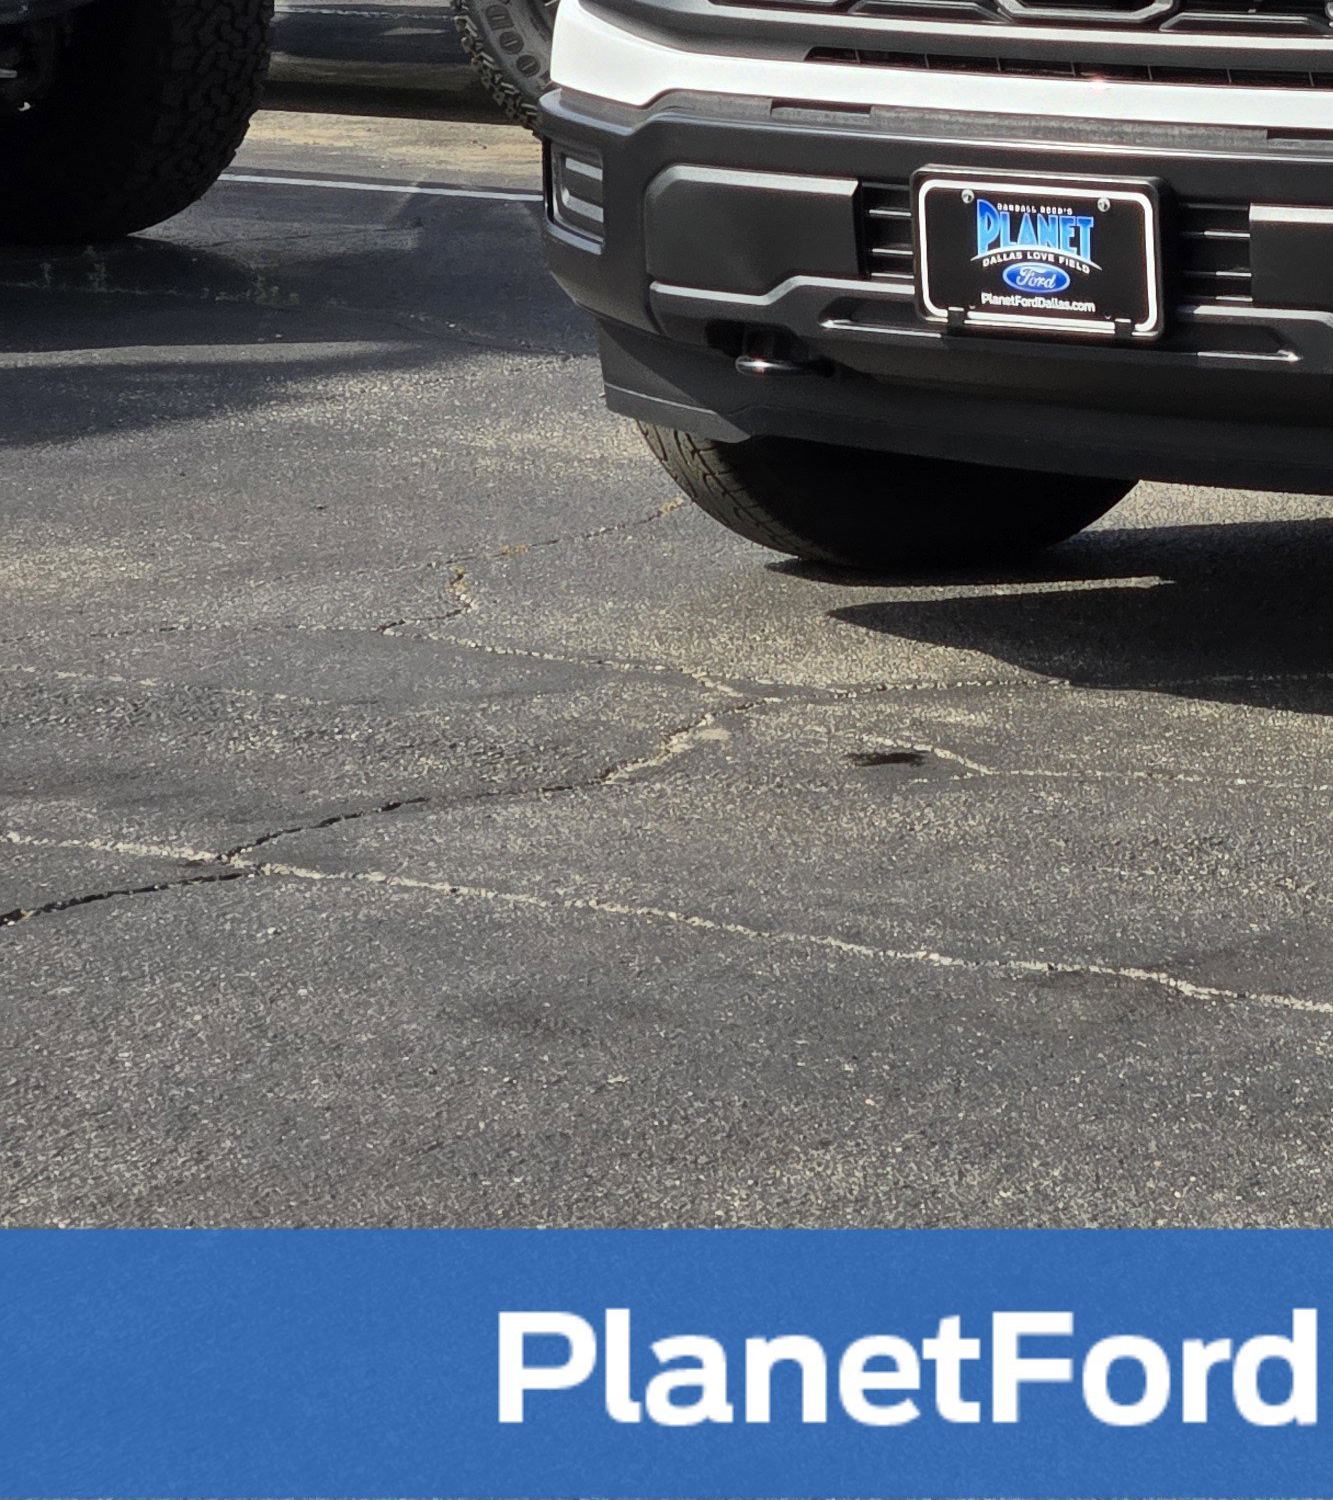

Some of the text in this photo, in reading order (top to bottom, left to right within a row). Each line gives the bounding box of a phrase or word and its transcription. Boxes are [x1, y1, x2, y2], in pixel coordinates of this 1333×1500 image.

[976, 199, 1095, 263] PLANET
[982, 251, 1091, 275] DALLAS LOVE FIELD
[1015, 266, 1057, 289] Ford
[980, 291, 1096, 313] PlanetFordDallas.com
